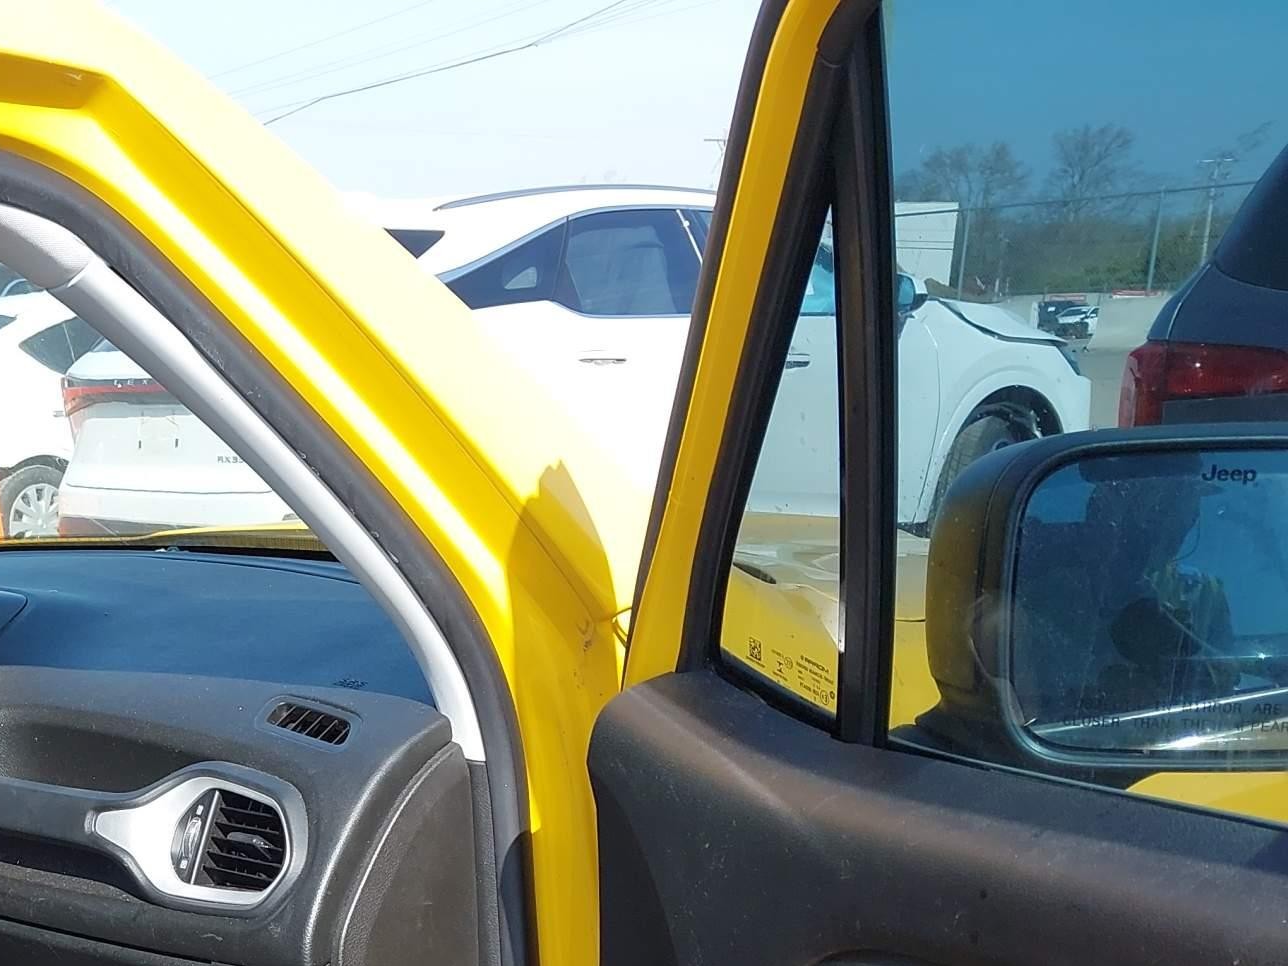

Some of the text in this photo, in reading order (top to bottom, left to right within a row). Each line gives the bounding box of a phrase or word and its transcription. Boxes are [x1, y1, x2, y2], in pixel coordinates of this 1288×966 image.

[1202, 464, 1256, 484] Jeep
[1253, 703, 1281, 715] ARE
[1134, 718, 1170, 731] THAN
